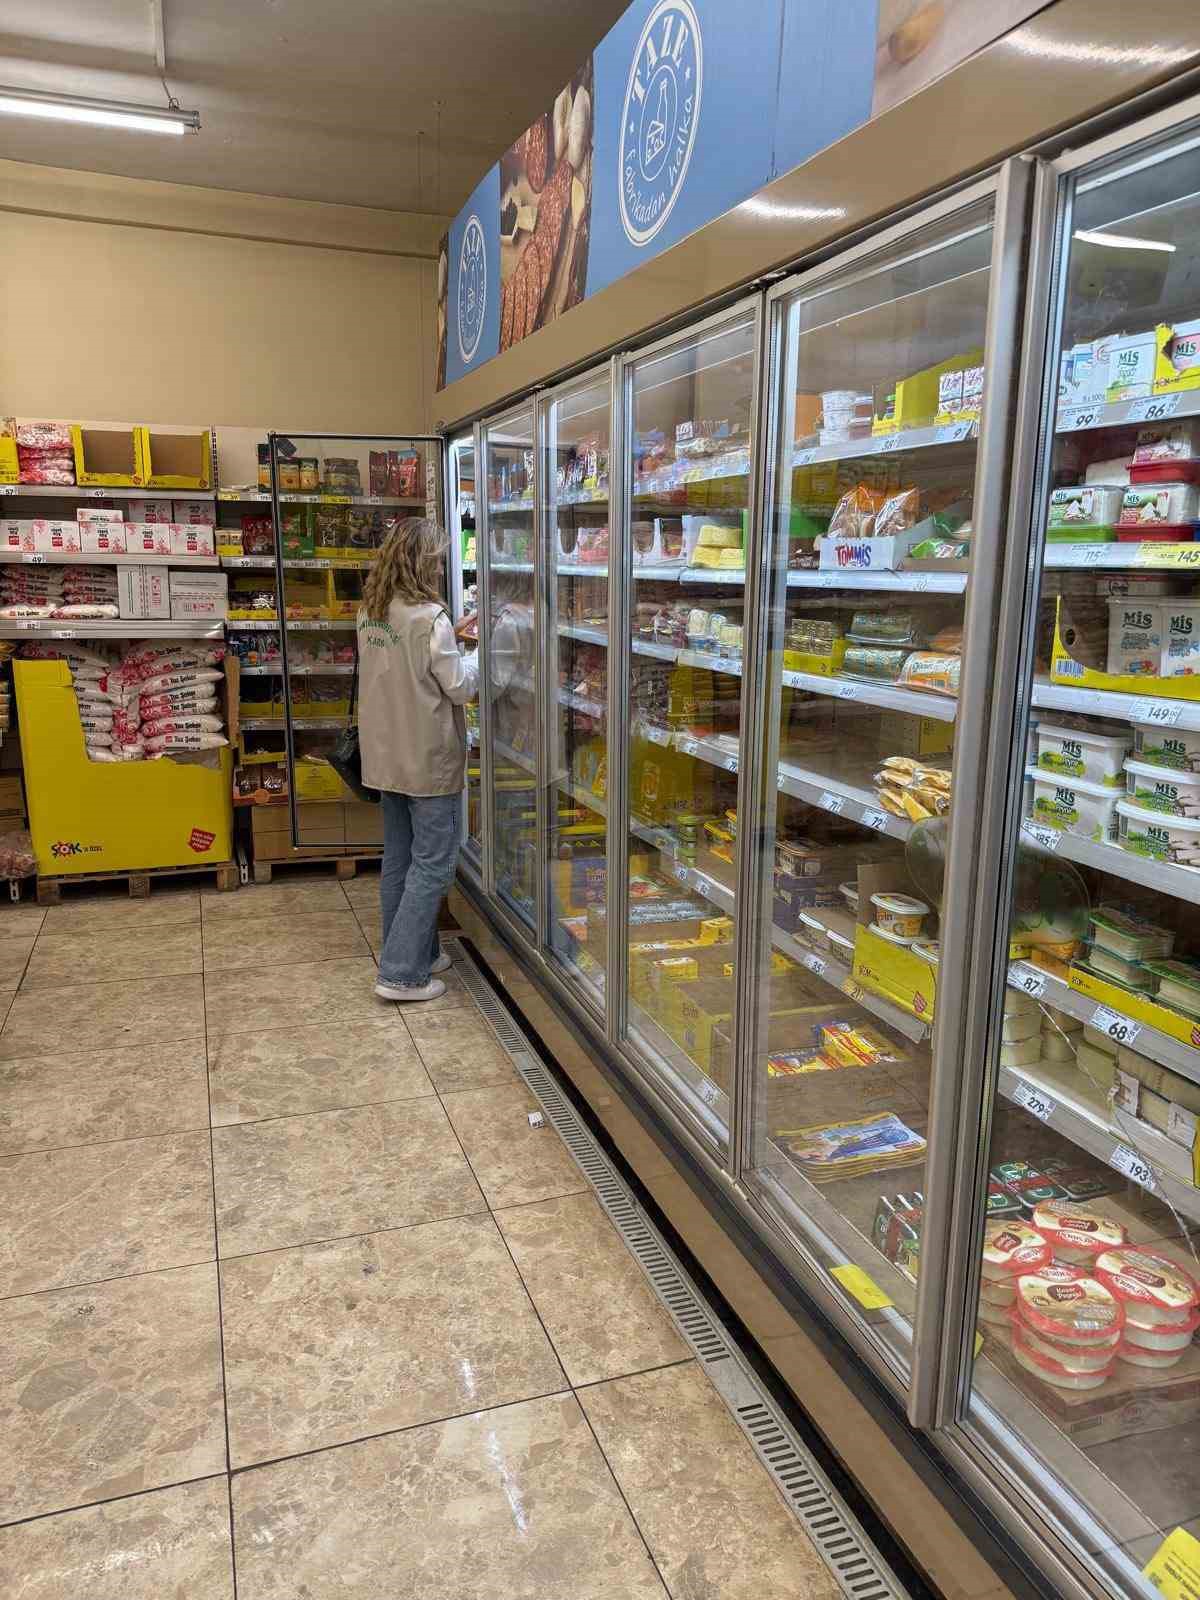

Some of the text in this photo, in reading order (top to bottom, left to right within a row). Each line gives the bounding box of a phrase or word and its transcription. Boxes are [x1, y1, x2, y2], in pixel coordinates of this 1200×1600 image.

[632, 15, 688, 105] TAZE
[1144, 404, 1164, 418] 86
[1076, 414, 1093, 426] 99
[1023, 976, 1041, 993] 87
[1108, 1021, 1127, 1041] 68
[1026, 1096, 1045, 1113] 279
[1129, 1162, 1147, 1182] 193
